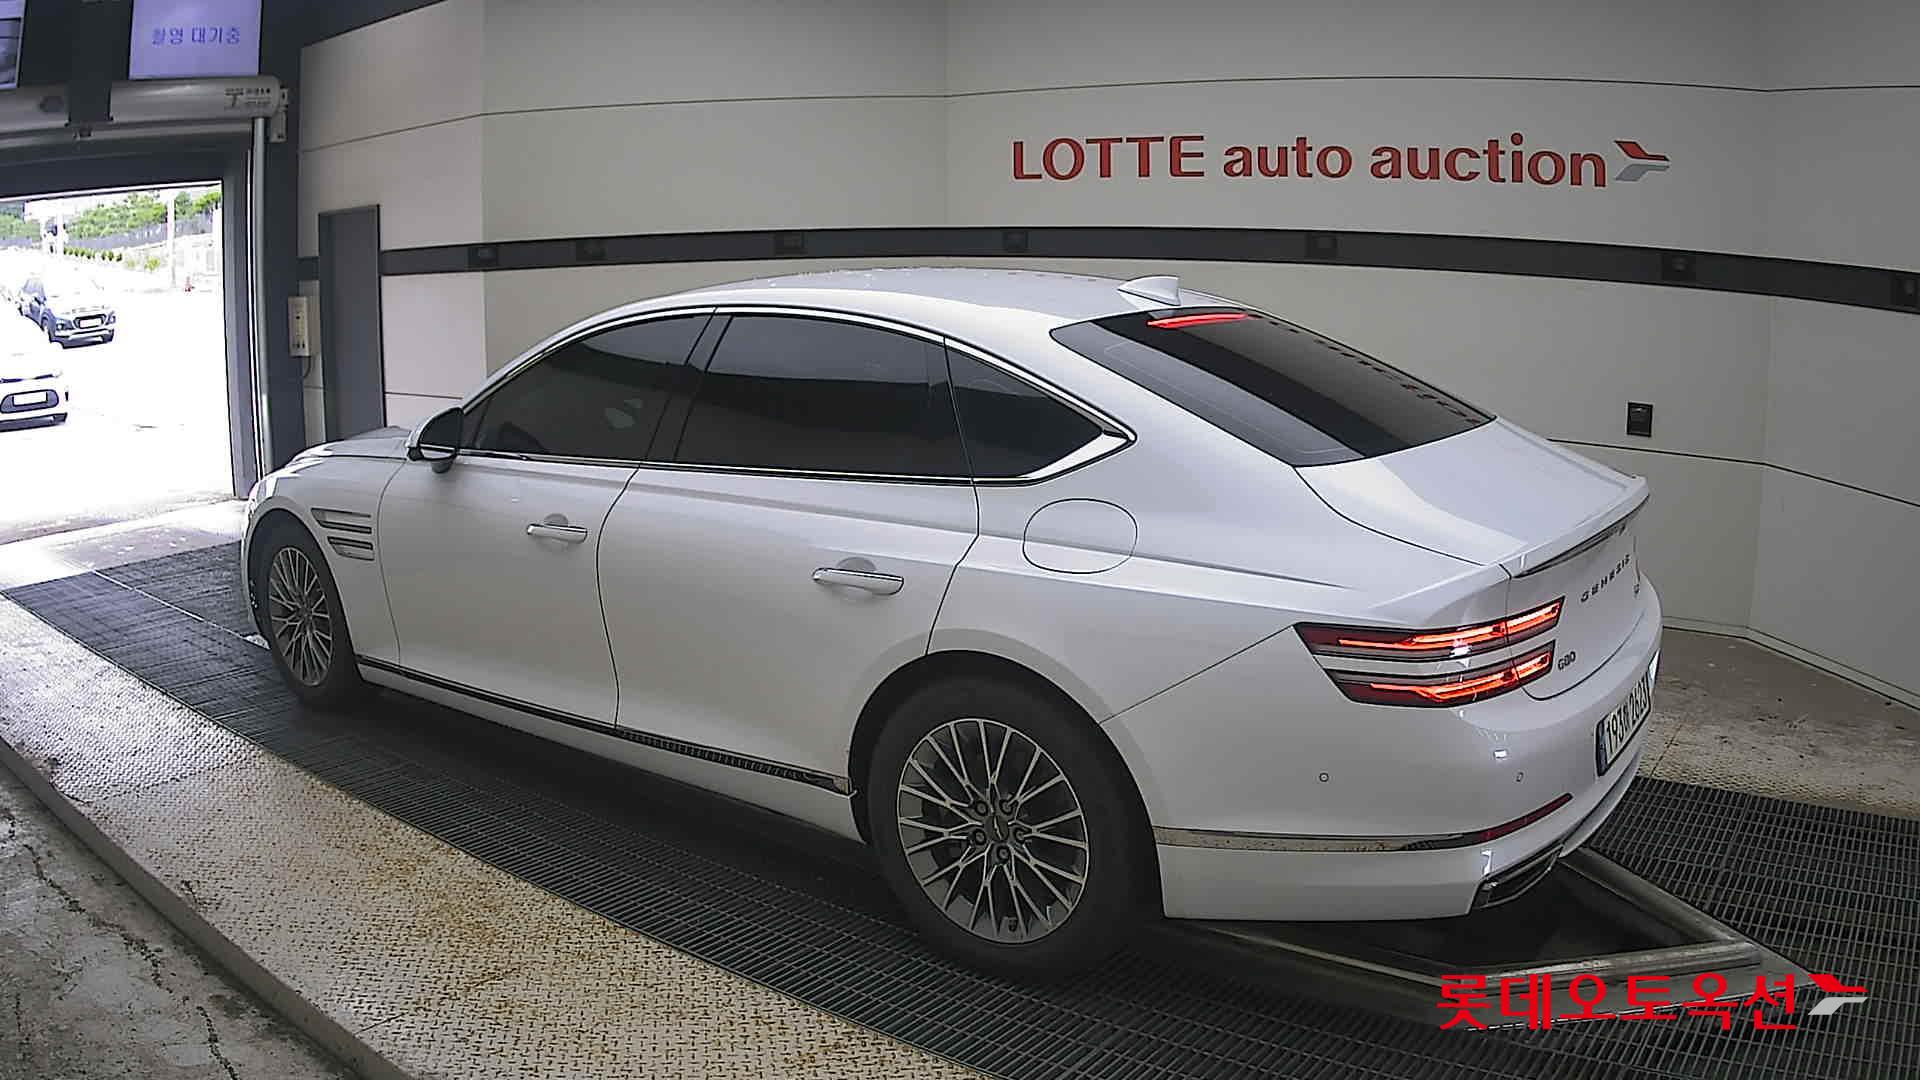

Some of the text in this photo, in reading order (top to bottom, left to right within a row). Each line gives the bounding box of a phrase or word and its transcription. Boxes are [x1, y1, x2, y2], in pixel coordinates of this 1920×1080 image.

[191, 26, 241, 45] 대기중
[1012, 132, 1607, 188] LOTTE auto auction
[1580, 553, 1631, 603] GENESIS
[1557, 650, 1576, 671] G80
